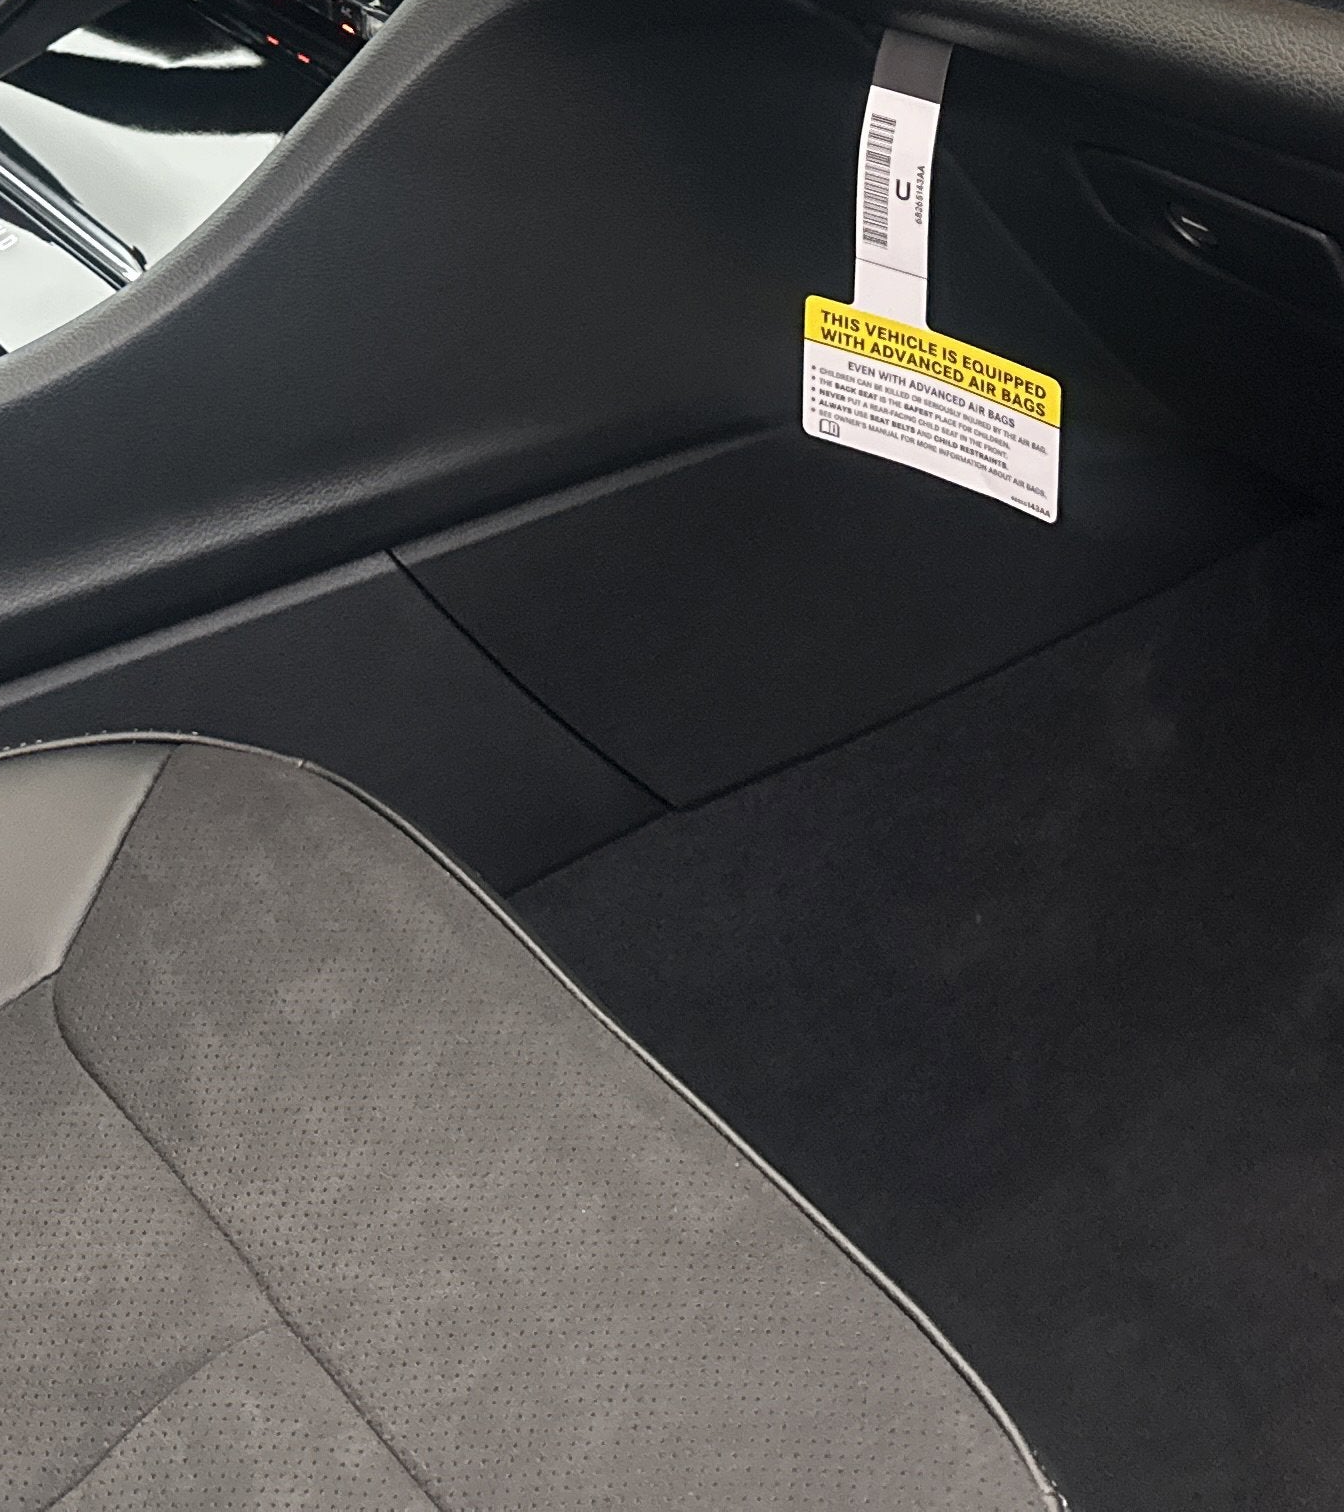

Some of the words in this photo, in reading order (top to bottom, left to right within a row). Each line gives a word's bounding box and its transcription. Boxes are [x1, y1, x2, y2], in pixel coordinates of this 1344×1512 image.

[895, 178, 912, 201] U
[820, 308, 860, 333] THIS
[864, 321, 937, 357] VEHICLE
[941, 346, 957, 365] IS
[961, 354, 1047, 401] EQUIPPED
[820, 325, 865, 351] WITH
[869, 339, 964, 384] ADVANCED
[968, 374, 996, 397] AIR
[1000, 386, 1046, 418] BAGS
[818, 398, 852, 415] ALWAYS
[847, 360, 875, 377] EVEN
[878, 369, 906, 387] WITH
[908, 378, 966, 408] ADVANCED
[968, 400, 985, 416] AIR
[987, 408, 1015, 429] BAGS
[1003, 429, 1016, 441] THE
[1017, 435, 1030, 447] AIR
